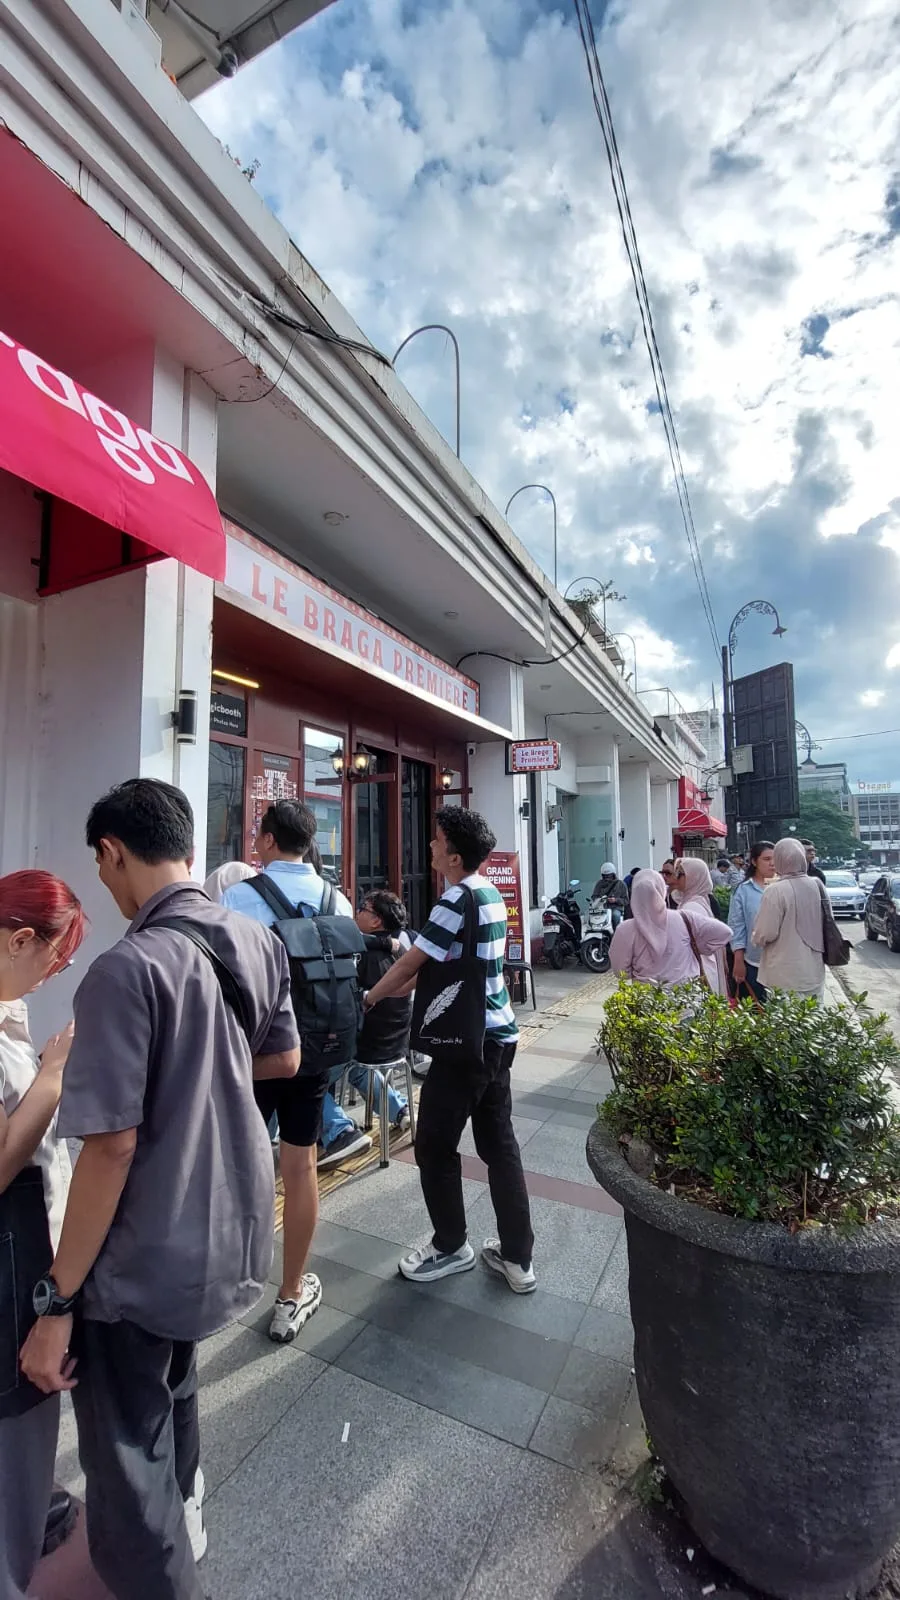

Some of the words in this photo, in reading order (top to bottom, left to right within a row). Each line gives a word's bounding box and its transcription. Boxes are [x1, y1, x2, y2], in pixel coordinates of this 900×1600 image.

[0, 331, 195, 486] aga
[251, 563, 288, 616] LE
[303, 594, 384, 670] BRAGA
[394, 649, 469, 711] PREMIERE
[486, 866, 512, 875] GRAND
[486, 875, 517, 884] PENING
